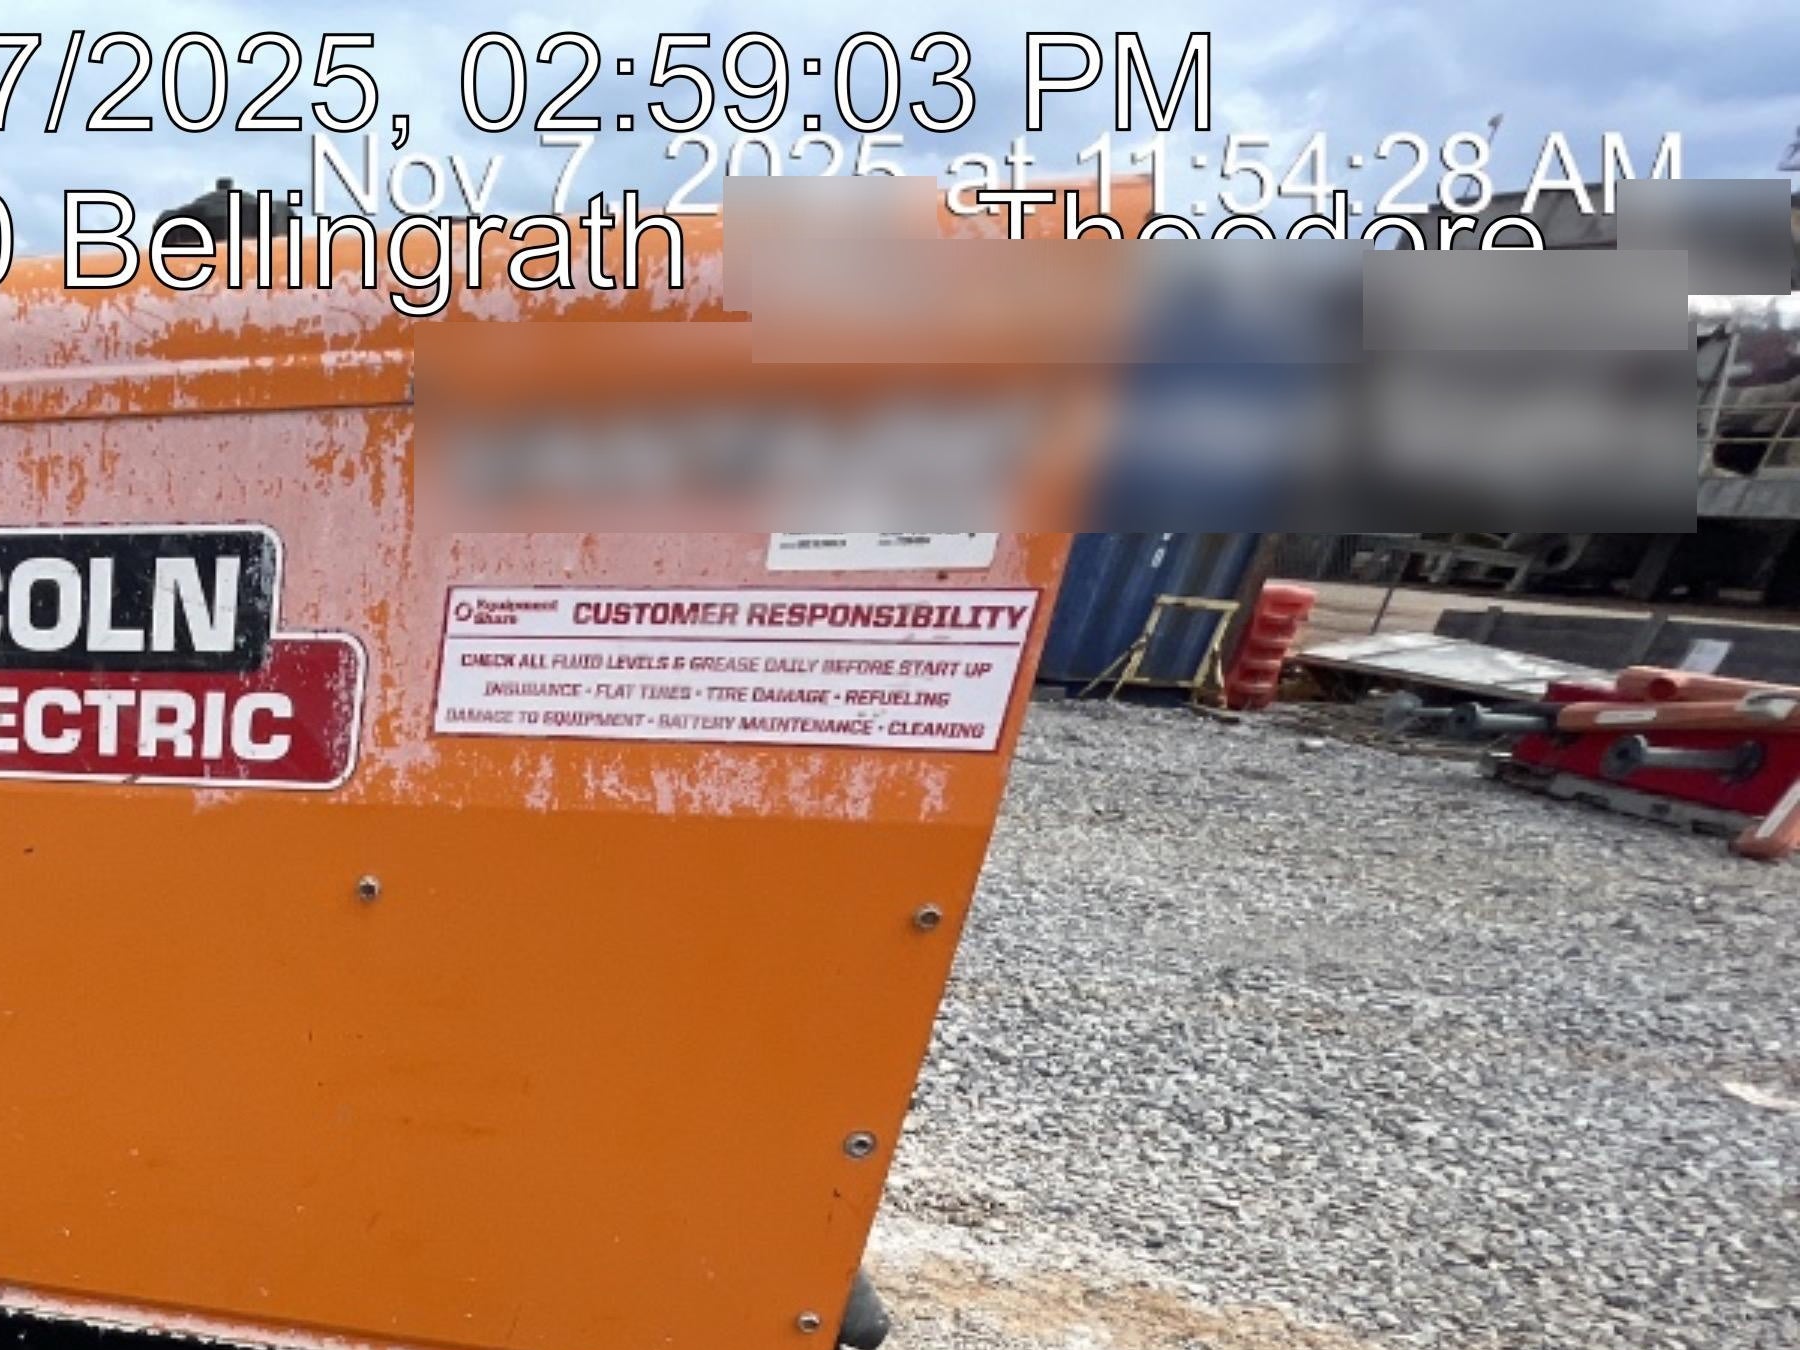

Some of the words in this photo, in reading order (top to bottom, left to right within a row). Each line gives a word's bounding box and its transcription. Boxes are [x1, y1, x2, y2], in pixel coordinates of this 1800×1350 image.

[572, 602, 738, 626] CUSTOMER
[746, 603, 1028, 630] RESPONSIBILITY
[460, 653, 514, 668] CHECK
[518, 653, 548, 669] ALL
[552, 654, 603, 670] FLUID
[606, 656, 668, 671] LEVELS
[689, 656, 760, 673] GREASE
[764, 657, 819, 674] DAILY
[822, 659, 896, 676] BEFORE
[899, 660, 960, 677] START
[965, 662, 993, 677] UP
[483, 680, 583, 698] INSURANCE
[593, 683, 634, 699] FLAT
[640, 684, 691, 701] TIRES
[706, 686, 748, 703] TIRE
[752, 687, 831, 705] DAMAGE
[845, 690, 951, 708] REFUELING
[445, 707, 514, 724] DAMAGE
[519, 710, 539, 725] TO
[542, 710, 647, 728] EQUIPMENT
[658, 714, 737, 731] BATTERY
[739, 716, 874, 736] MAINTENANCE
[887, 721, 985, 739] CLEANING
